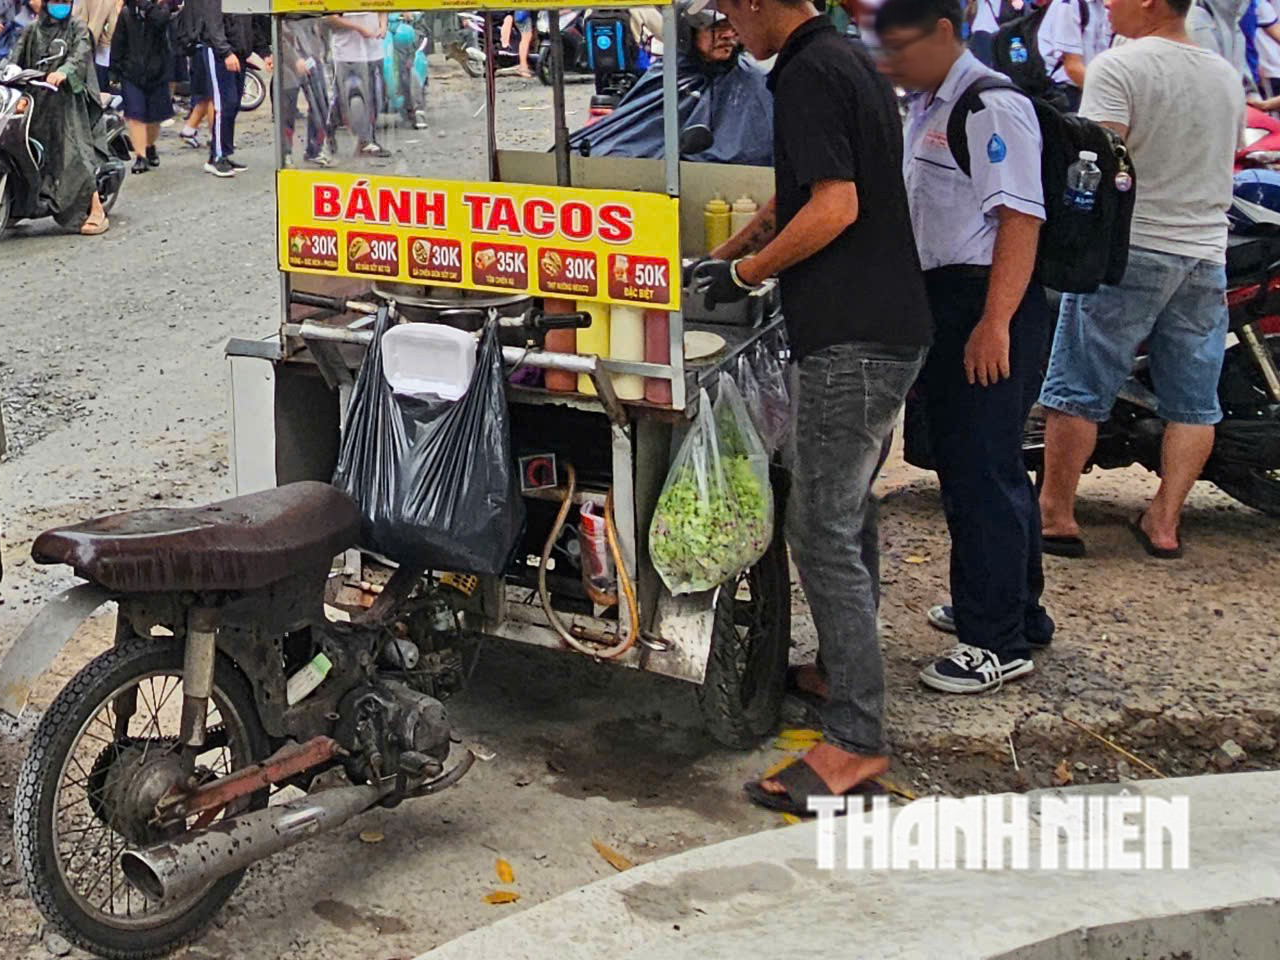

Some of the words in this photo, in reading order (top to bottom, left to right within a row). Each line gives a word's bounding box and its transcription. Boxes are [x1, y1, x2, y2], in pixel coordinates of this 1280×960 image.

[312, 179, 448, 230] BÁNH
[463, 194, 635, 244] TACOS
[311, 235, 337, 256] 30K
[370, 240, 397, 261] 30K
[431, 245, 460, 267] 30K
[497, 251, 526, 273] 35K
[565, 257, 595, 281] 30K
[634, 263, 667, 287] 50K
[624, 286, 638, 299] ĐẶC
[639, 288, 654, 300] BIỆT
